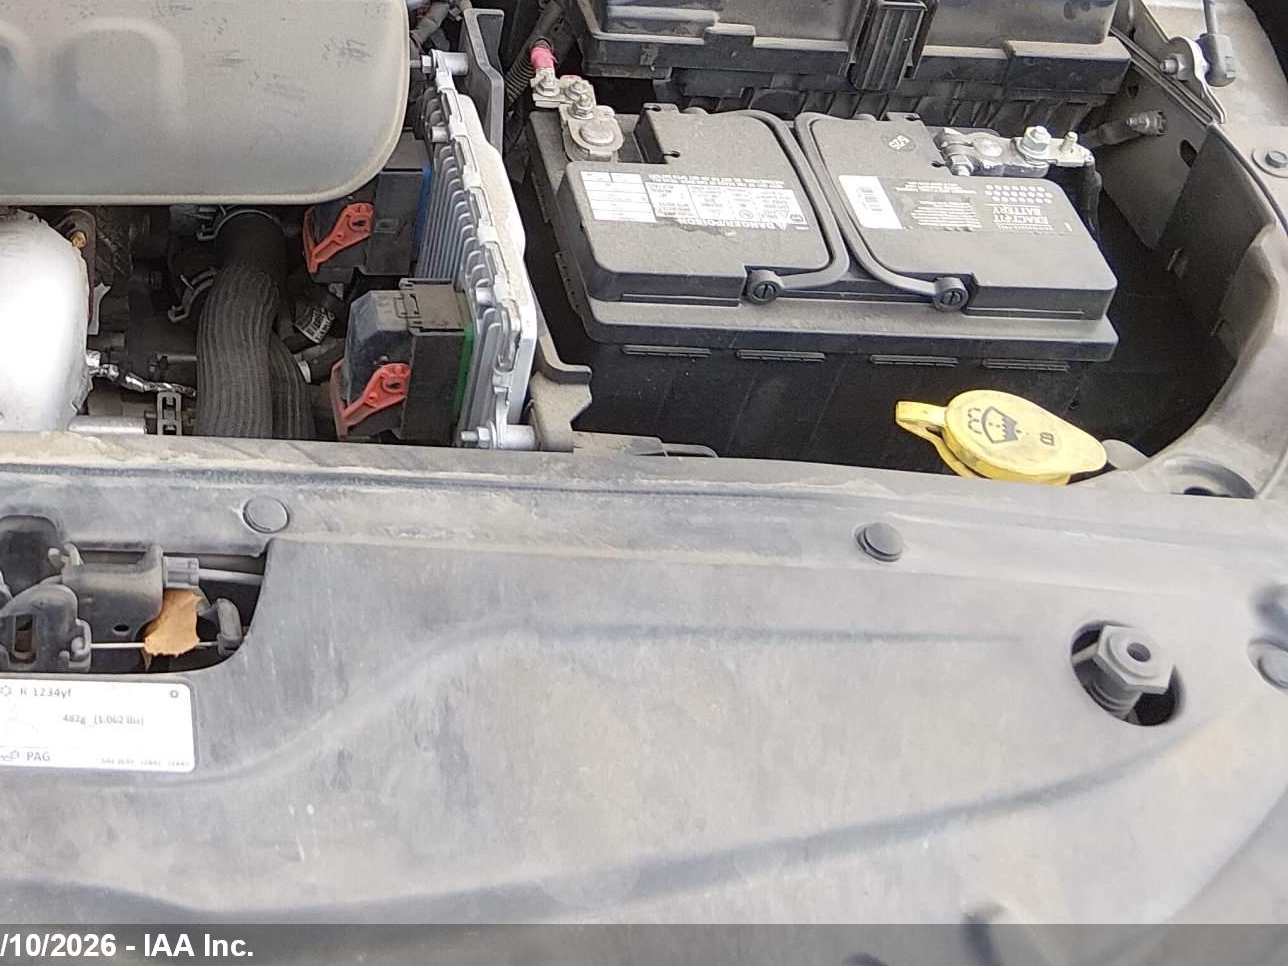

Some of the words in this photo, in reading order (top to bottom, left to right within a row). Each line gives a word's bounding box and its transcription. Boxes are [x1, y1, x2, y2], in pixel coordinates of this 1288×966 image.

[33, 687, 72, 699] 1234yf
[63, 714, 87, 726] 482g
[26, 751, 51, 762] PAG
